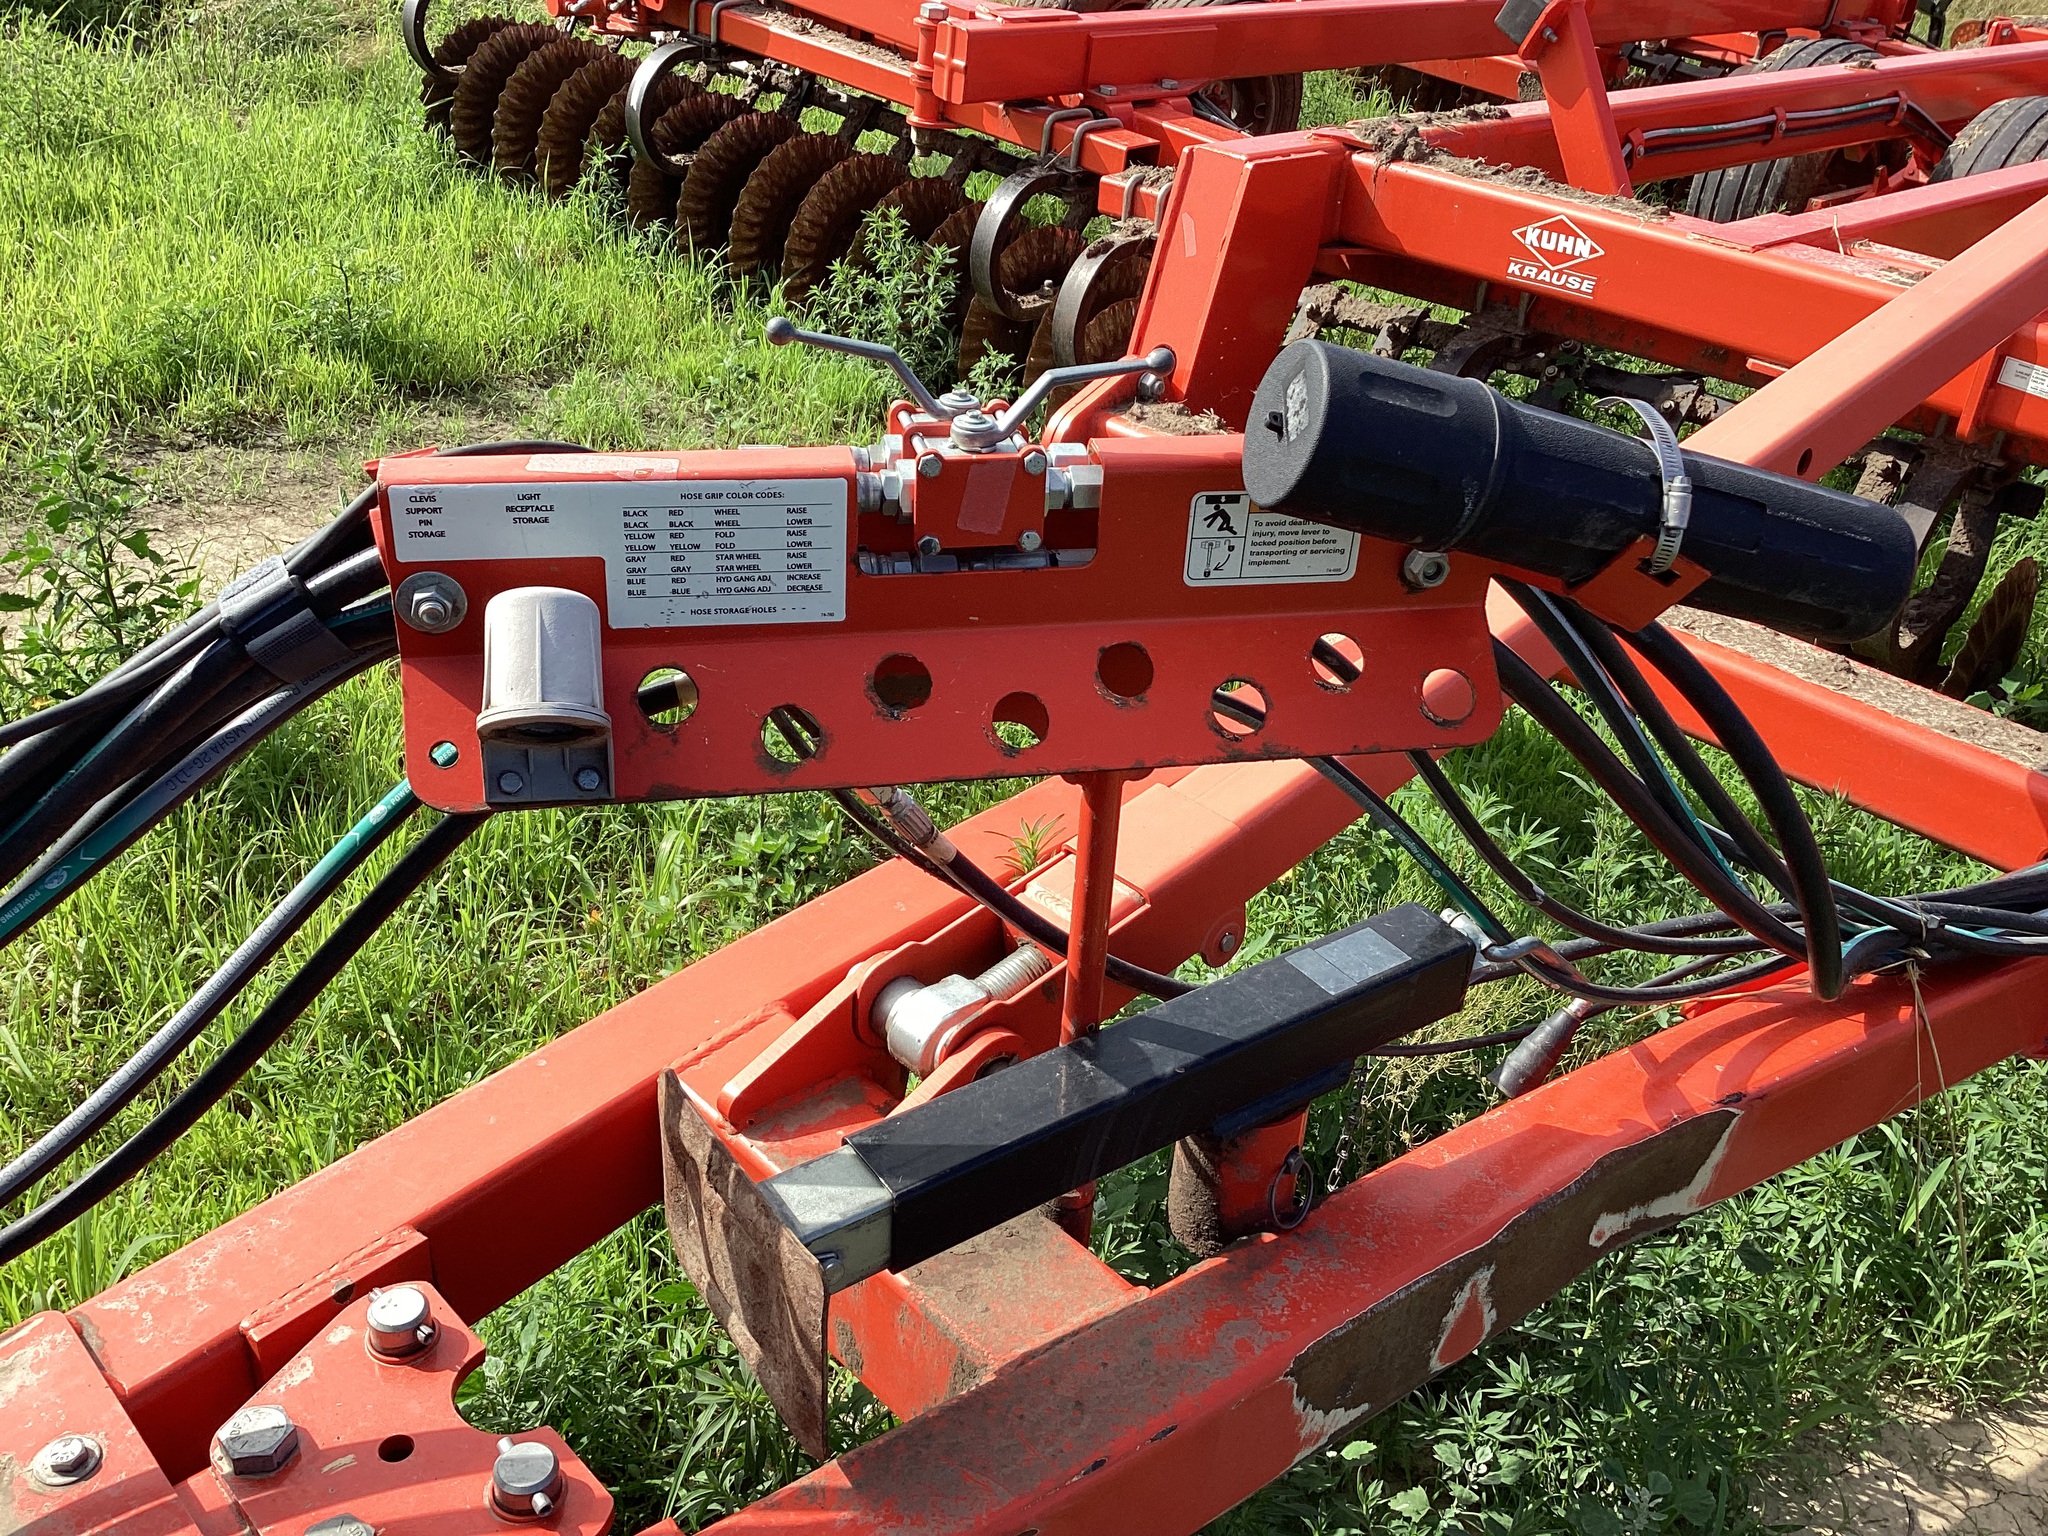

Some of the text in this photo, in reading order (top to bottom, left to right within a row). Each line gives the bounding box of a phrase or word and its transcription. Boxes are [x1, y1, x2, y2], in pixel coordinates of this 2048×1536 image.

[1524, 226, 1592, 259] KUHN
[1507, 262, 1597, 294] KRAUSE
[409, 495, 436, 503] CLEVIS
[680, 492, 702, 500] HOSE
[705, 492, 723, 500] GRIP
[786, 518, 813, 526] LOWER
[1278, 539, 1310, 547] position
[1250, 549, 1297, 557] transporting
[1310, 547, 1345, 555] servicing
[715, 564, 734, 572] STAR
[757, 575, 771, 583] ADJ
[757, 586, 771, 594] ADJ
[690, 606, 777, 616] HOSE STORAGE HOLES
[209, 724, 247, 757] MSHA
[0, 889, 40, 924] POWERING
[28, 1139, 53, 1164] SAE
[51, 1101, 97, 1143] 100R16
[101, 1075, 125, 1100] SAE
[156, 1012, 189, 1048] Flame
[186, 967, 233, 1016] Resistant
[230, 938, 260, 973] MSHA
[256, 901, 294, 942] 2G-11C
